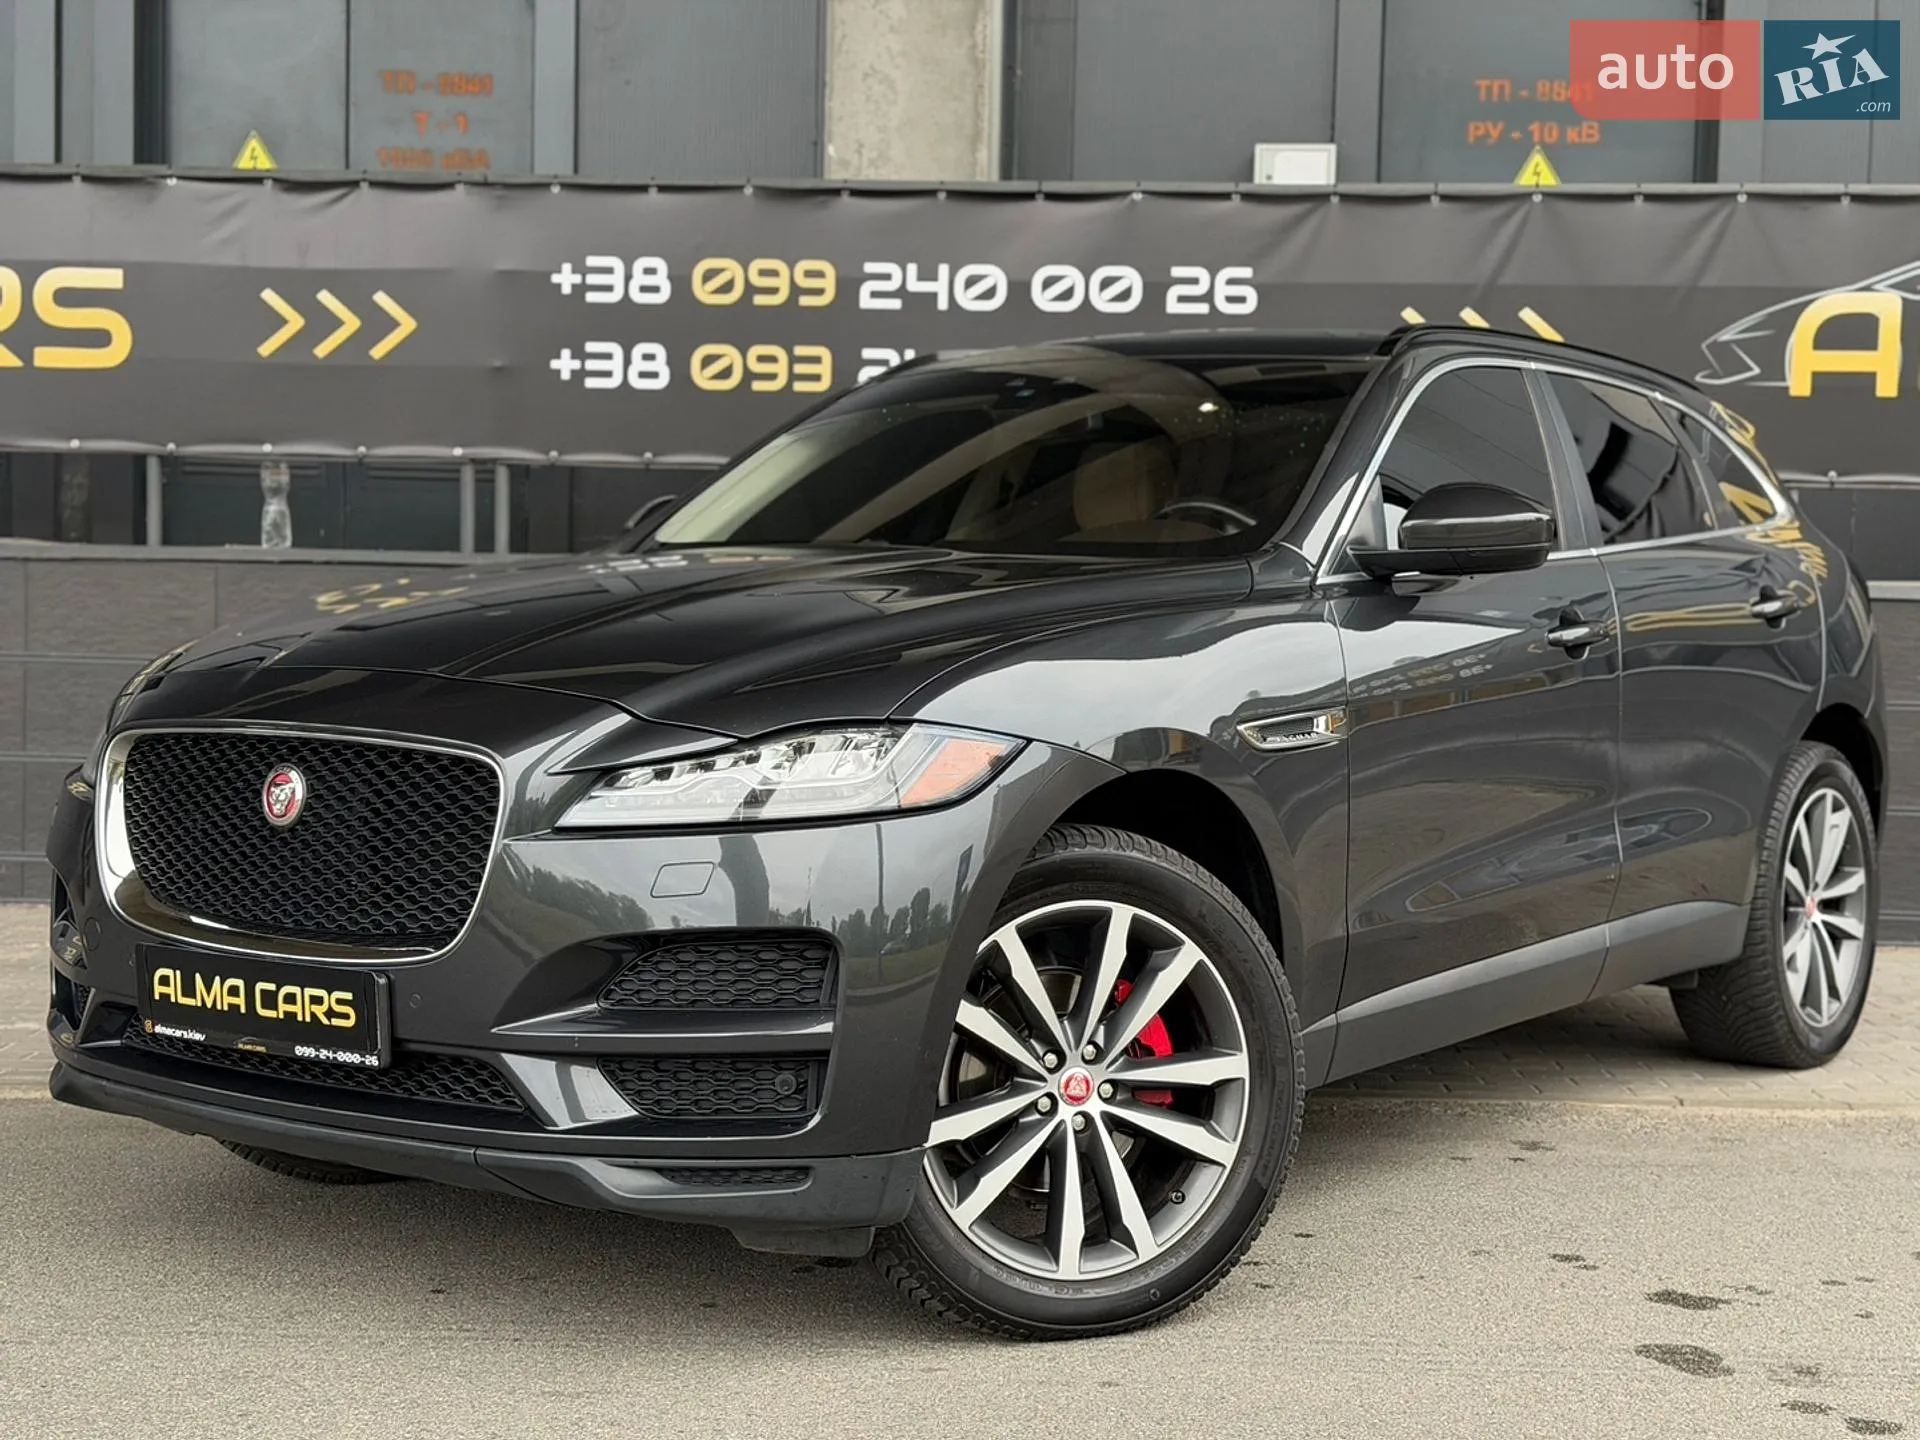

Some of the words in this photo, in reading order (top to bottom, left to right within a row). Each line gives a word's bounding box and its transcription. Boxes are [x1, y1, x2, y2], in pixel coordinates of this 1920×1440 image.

[1475, 79, 1512, 103] ТП
[452, 111, 469, 136] 1
[1467, 121, 1505, 145] РУ
[1527, 121, 1561, 144] 10
[551, 255, 672, 305] +38
[691, 257, 837, 307] 099
[858, 261, 1008, 312] 240
[1030, 264, 1143, 314] 00
[1165, 265, 1258, 315] 26
[549, 341, 671, 391] +38
[690, 343, 833, 392] 093
[153, 967, 246, 1015] ALMA
[254, 981, 356, 1028] CARS
